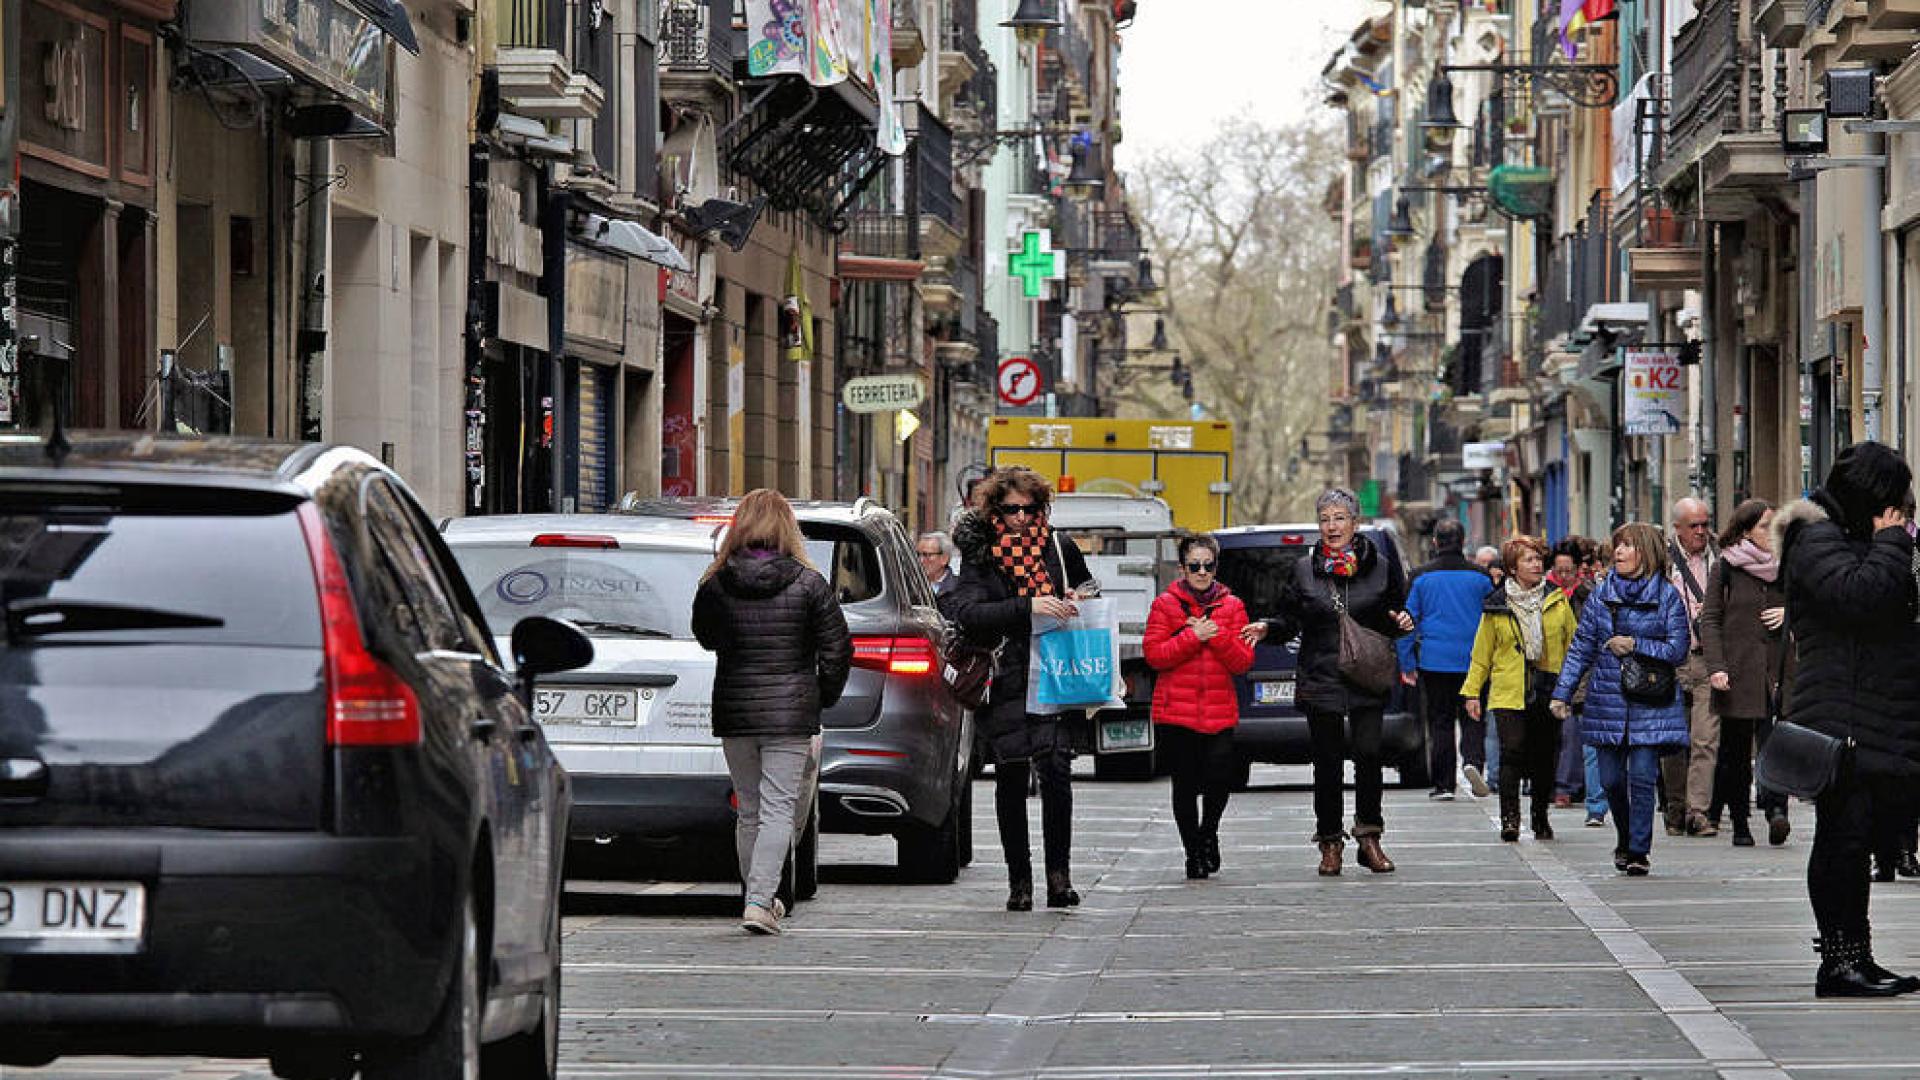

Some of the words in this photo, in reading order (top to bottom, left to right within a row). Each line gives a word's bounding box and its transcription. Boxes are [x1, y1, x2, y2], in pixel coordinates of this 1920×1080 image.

[1649, 367, 1680, 389] K2
[850, 384, 918, 404] FERRETERIA
[584, 693, 627, 716] GKP
[43, 889, 127, 927] DNZ
